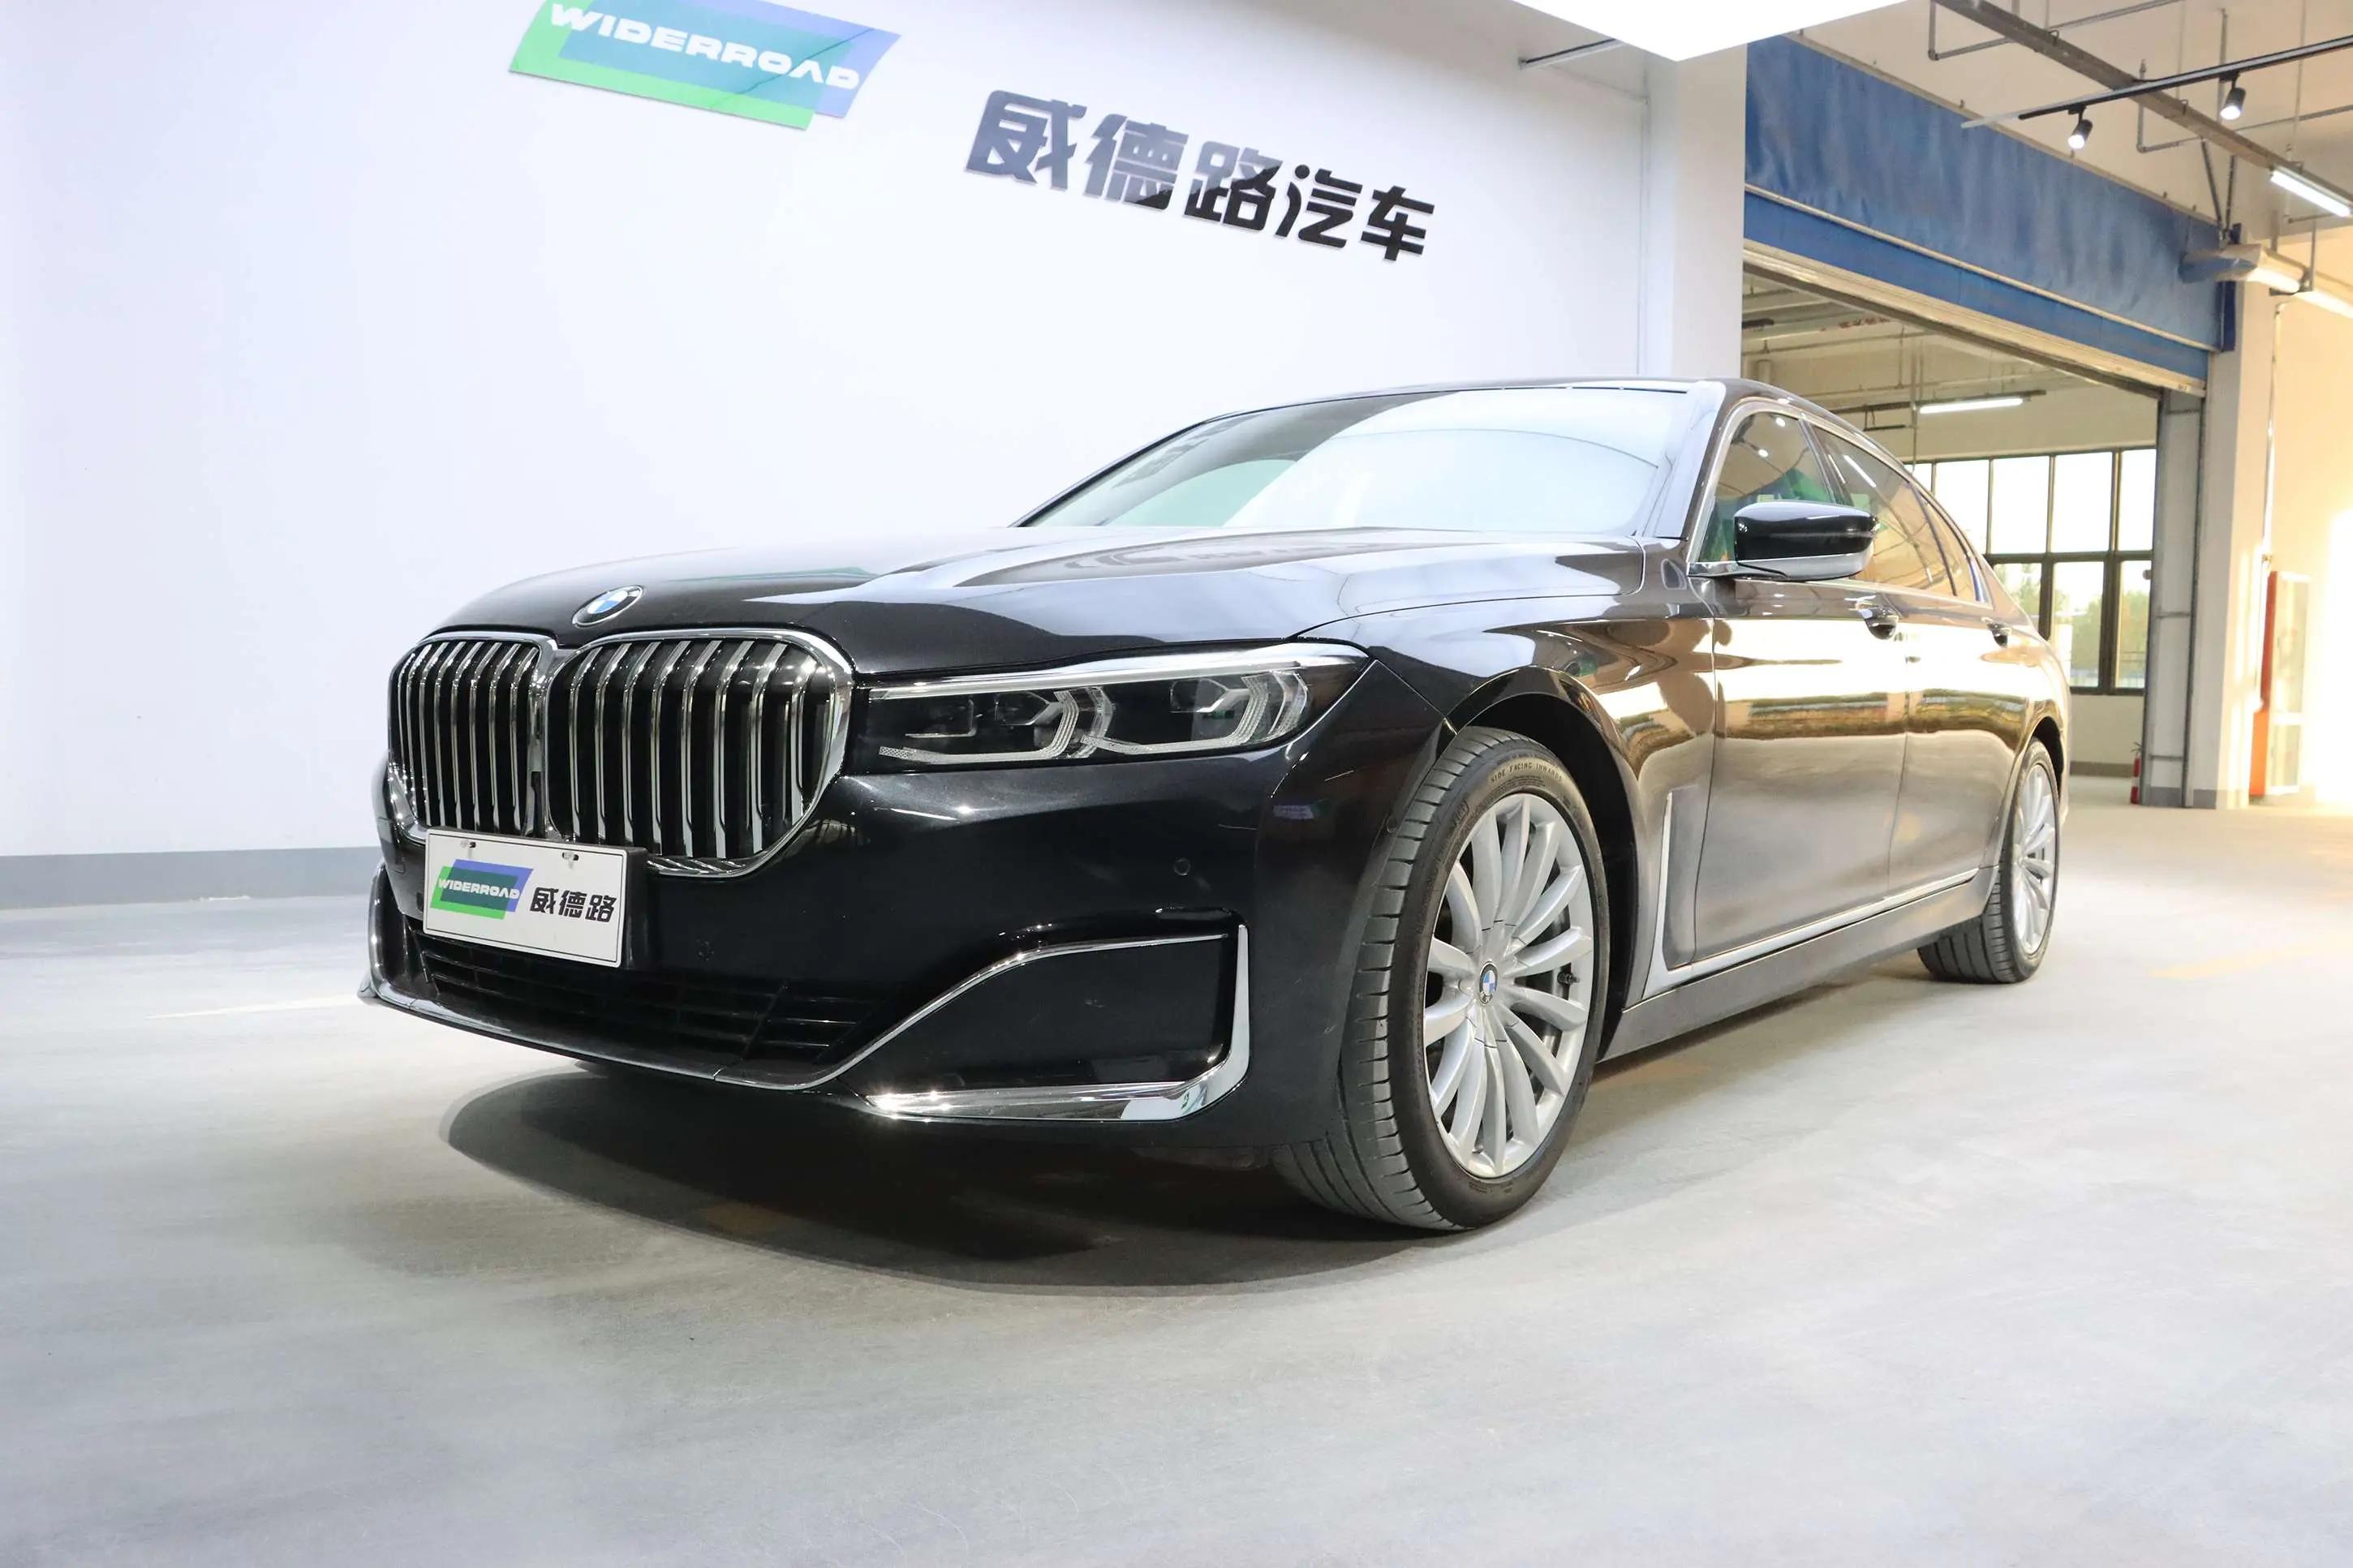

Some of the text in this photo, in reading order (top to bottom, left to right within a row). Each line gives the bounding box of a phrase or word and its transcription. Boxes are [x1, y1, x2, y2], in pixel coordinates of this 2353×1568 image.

[551, 3, 859, 90] WIDERROAD
[966, 89, 1435, 261] 威德路汽车
[1510, 763, 1533, 772] FACING
[438, 878, 521, 900] WIDERROAD
[529, 887, 617, 923] 威德路
